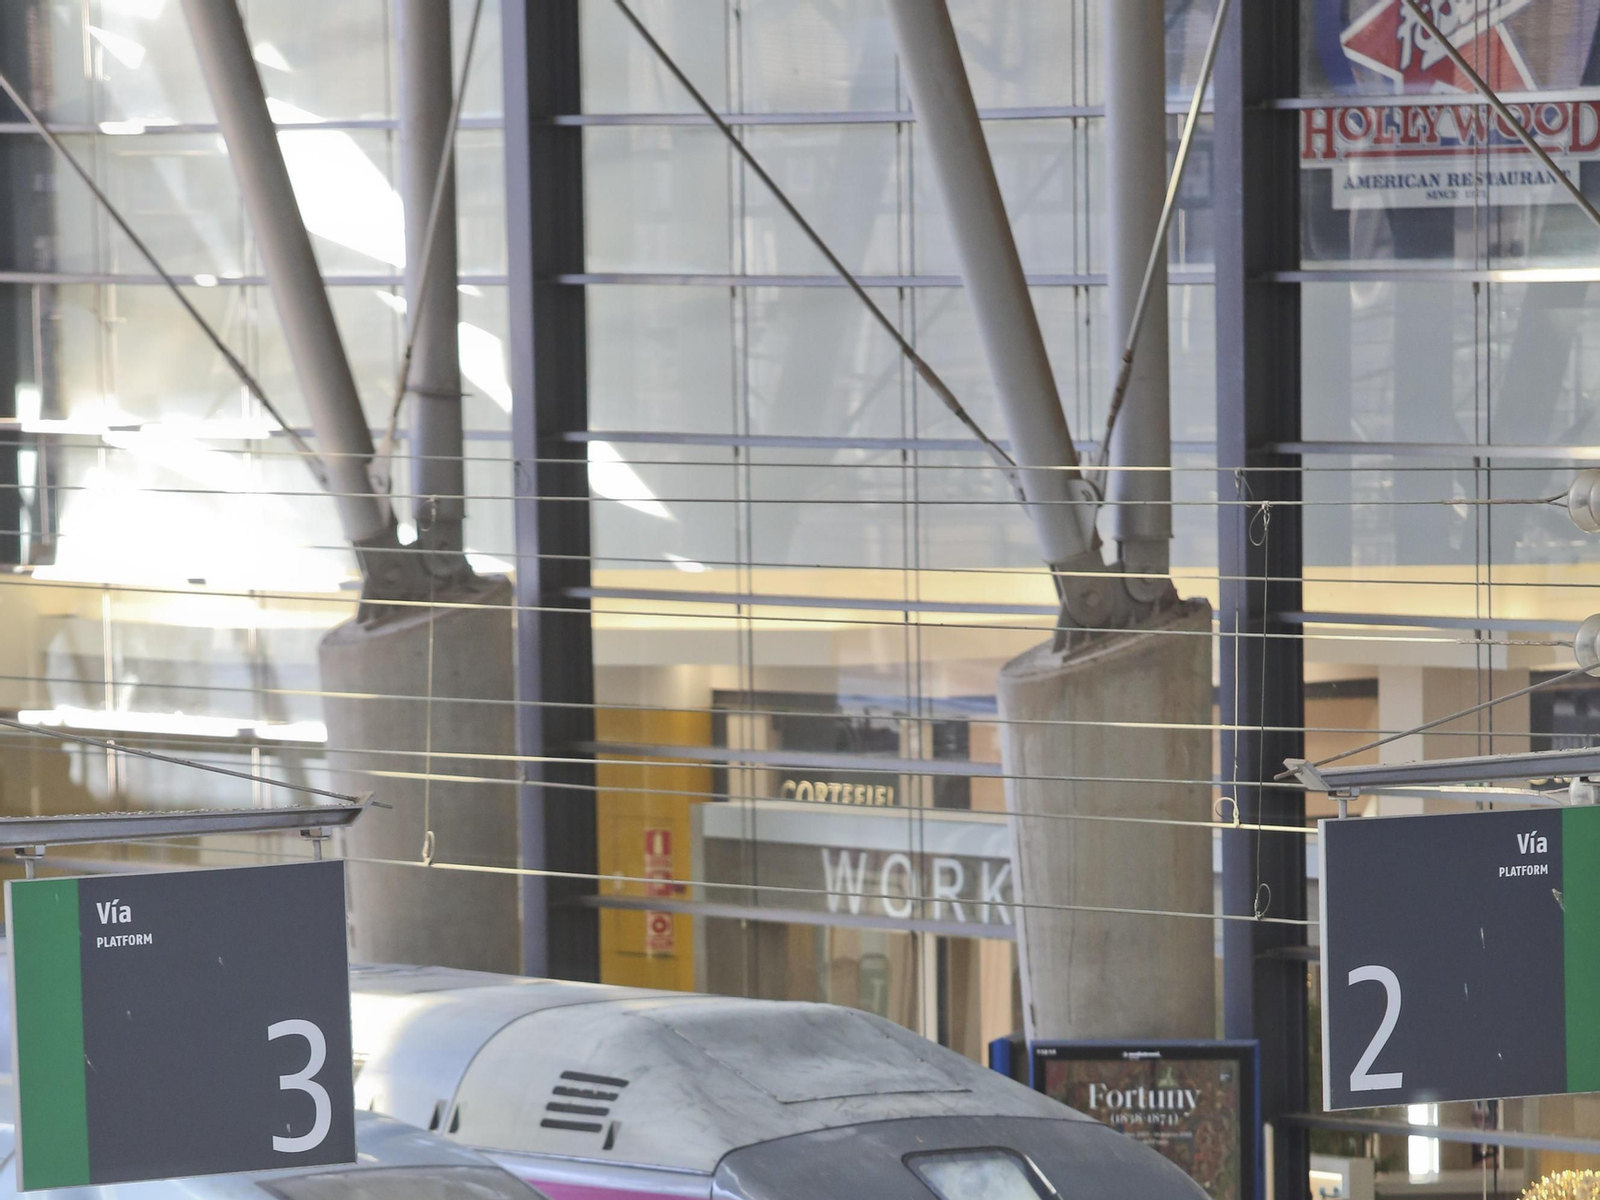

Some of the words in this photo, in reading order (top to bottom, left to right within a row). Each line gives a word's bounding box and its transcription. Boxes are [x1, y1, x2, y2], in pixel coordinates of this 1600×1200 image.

[1301, 102, 1600, 159] HOLLYWOOD
[1343, 171, 1441, 190] AMERICAN
[1516, 830, 1548, 855] Vía
[1499, 864, 1549, 878] PLATFORM
[96, 899, 132, 925] Vía
[96, 933, 153, 949] PLATFORM
[1348, 964, 1403, 1092] 2
[267, 1018, 333, 1153] 3
[1088, 1082, 1200, 1116] Fortuny
